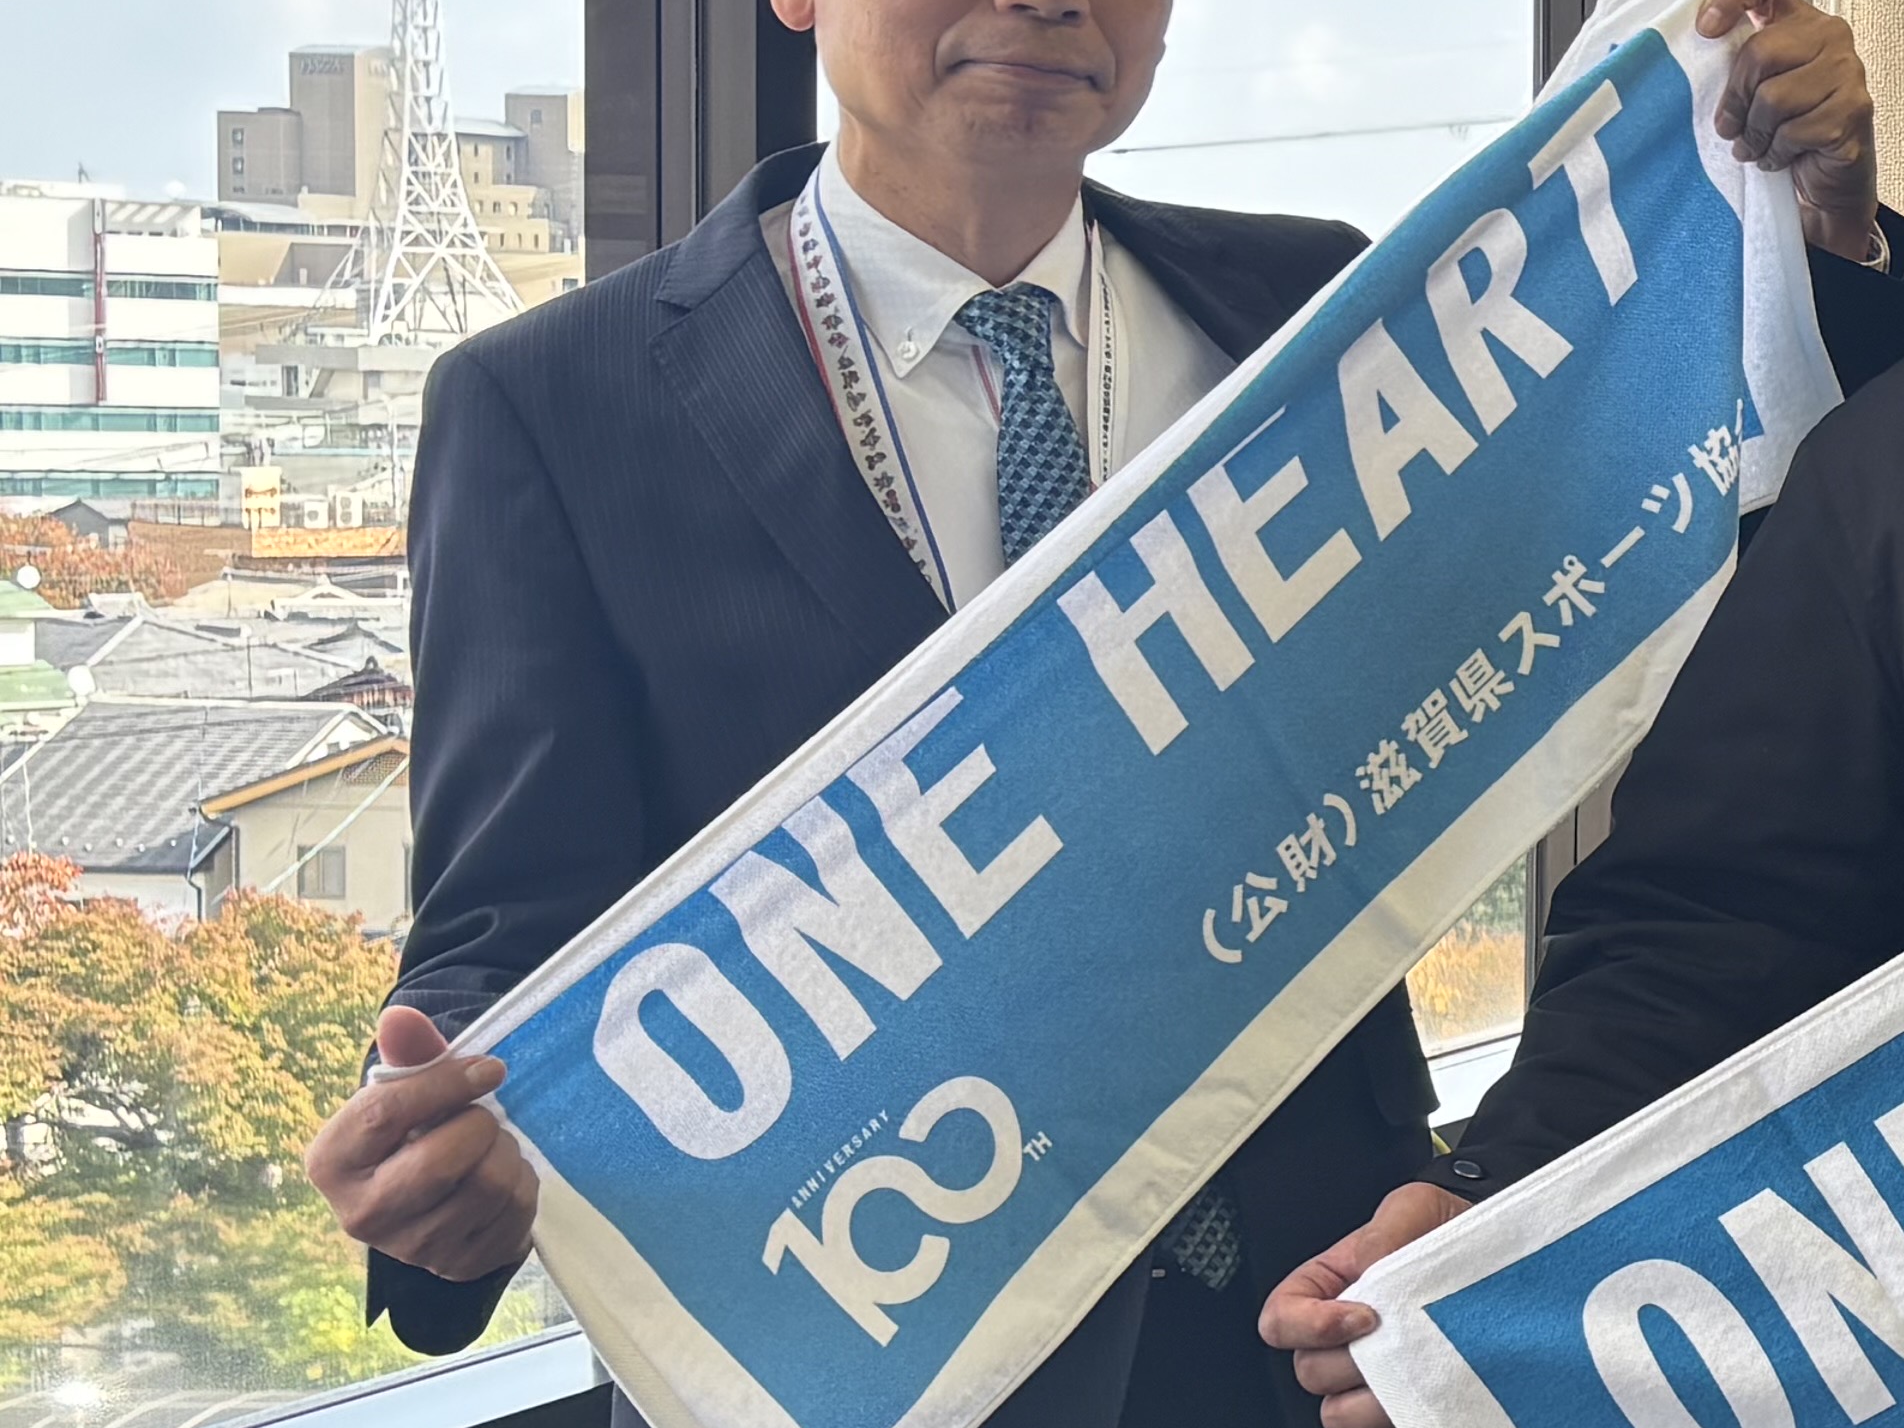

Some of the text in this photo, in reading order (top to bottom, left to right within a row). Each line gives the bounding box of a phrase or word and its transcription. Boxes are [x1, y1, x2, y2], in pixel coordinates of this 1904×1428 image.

[592, 77, 1657, 1162] ONE HEART
[789, 1107, 895, 1211] ANNIVERSARY
